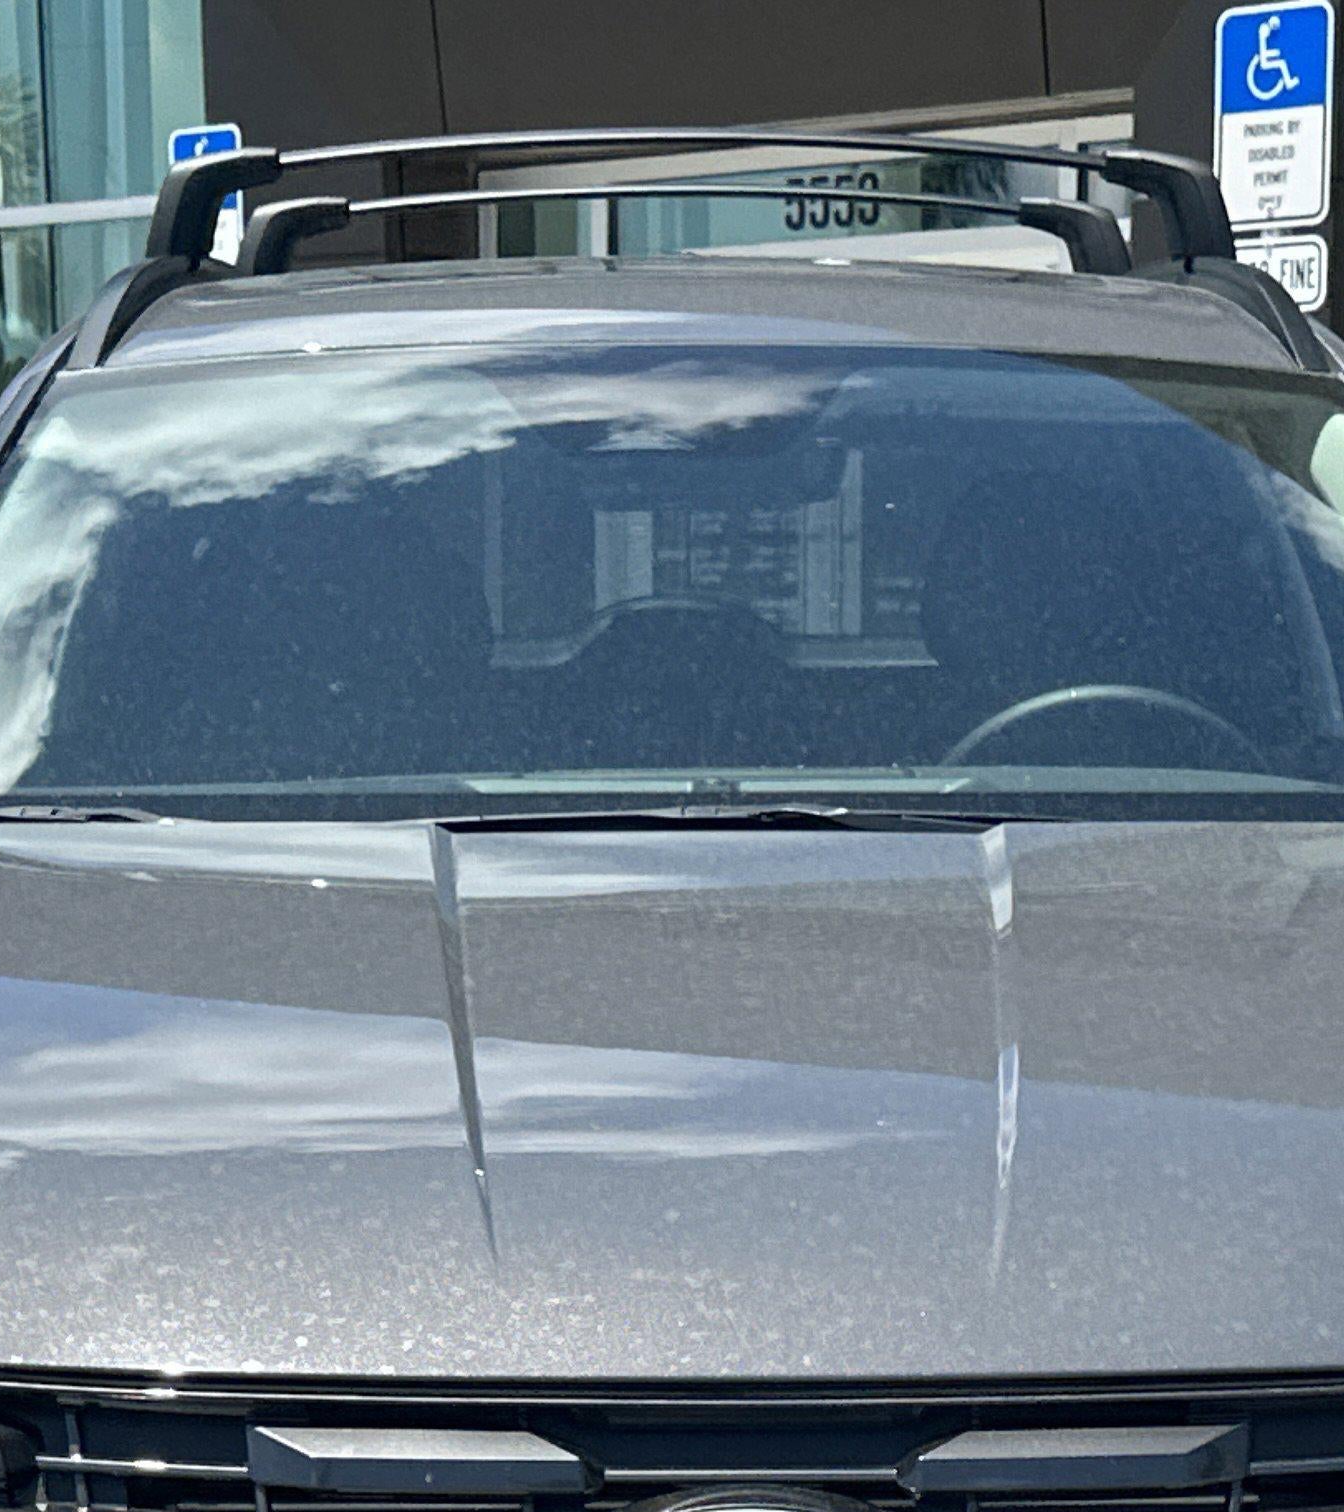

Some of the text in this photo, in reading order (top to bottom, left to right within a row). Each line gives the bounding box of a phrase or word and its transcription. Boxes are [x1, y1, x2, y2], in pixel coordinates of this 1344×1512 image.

[1248, 145, 1295, 163] DISABLED
[1253, 169, 1288, 187] PERMIT
[1280, 257, 1315, 289] FINE
